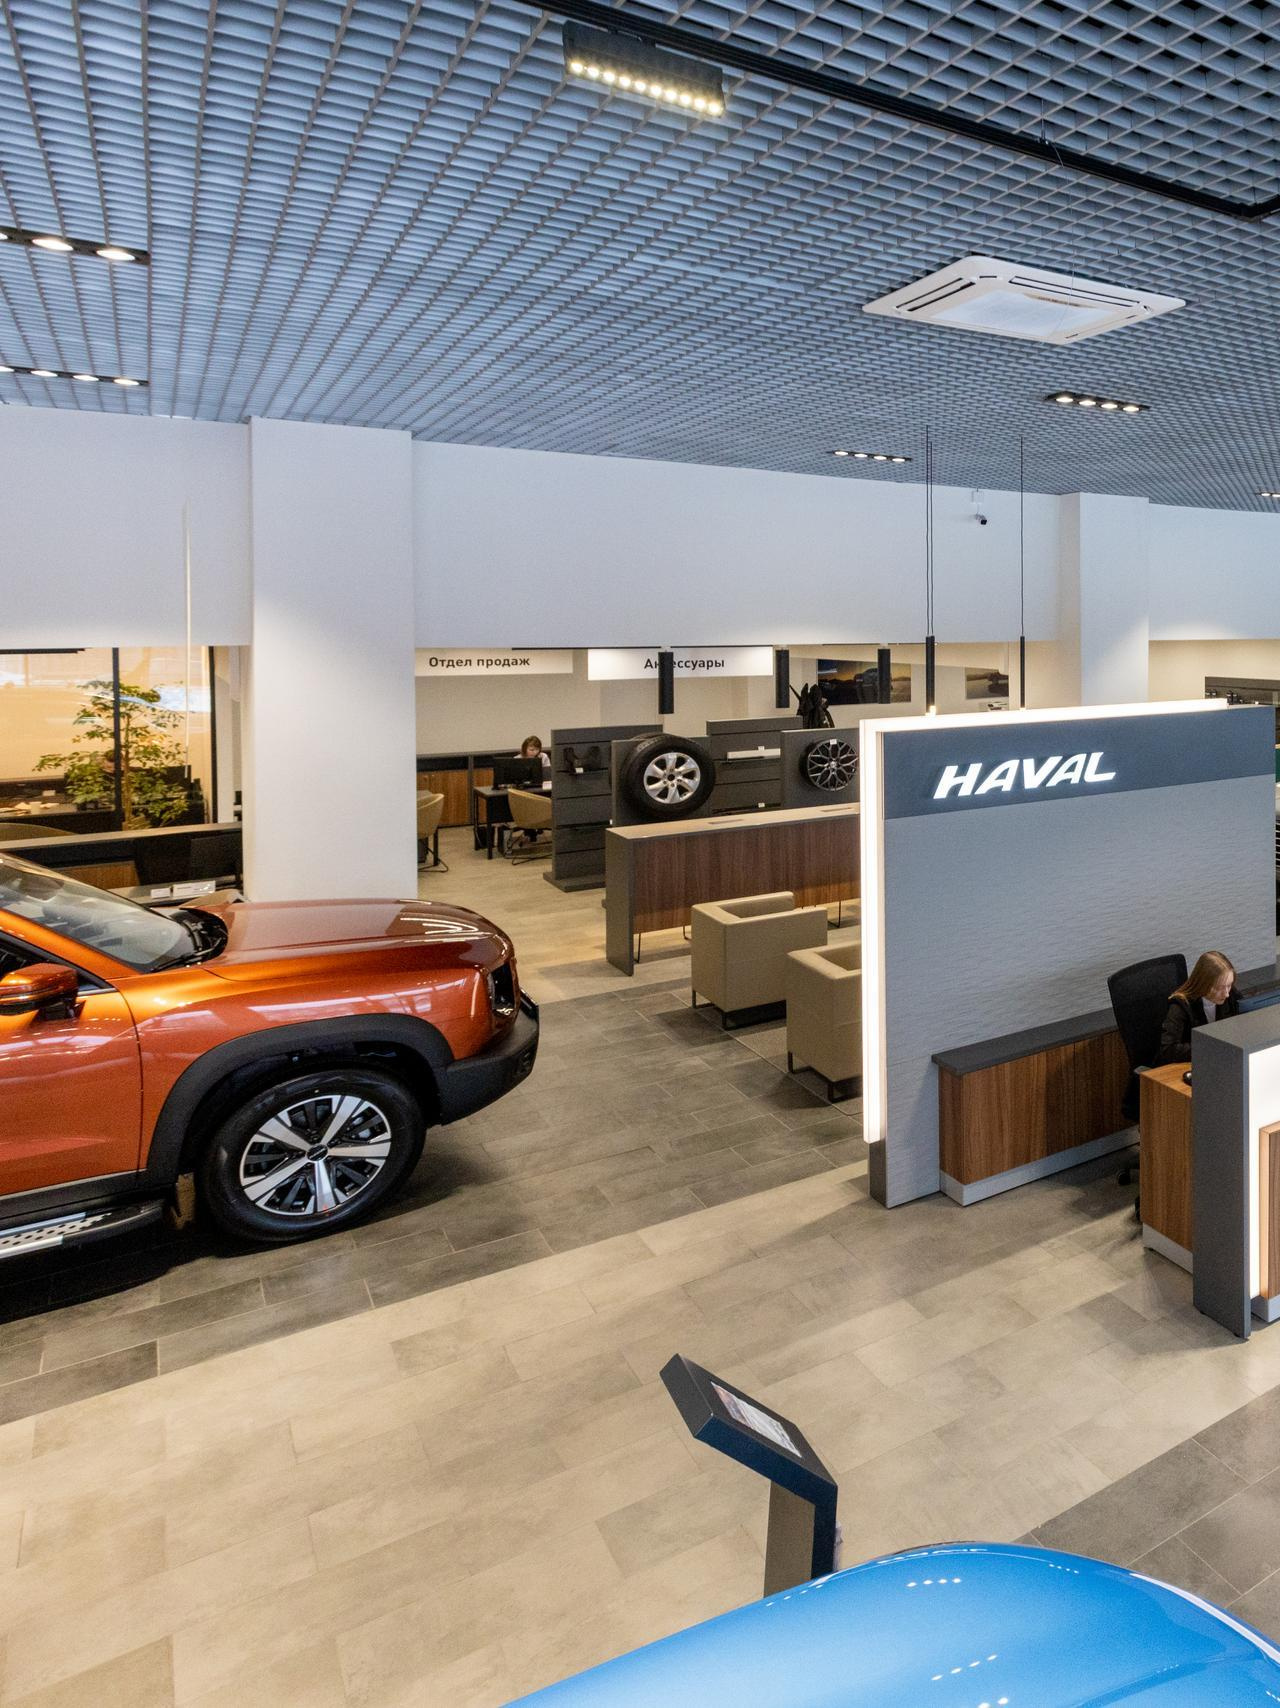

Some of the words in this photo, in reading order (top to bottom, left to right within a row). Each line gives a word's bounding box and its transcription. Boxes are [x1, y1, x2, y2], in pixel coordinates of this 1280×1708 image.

[429, 656, 472, 668] Отдел
[477, 657, 530, 669] продаж
[644, 658, 725, 671] Акессуары
[933, 751, 1116, 799] HAVAL
